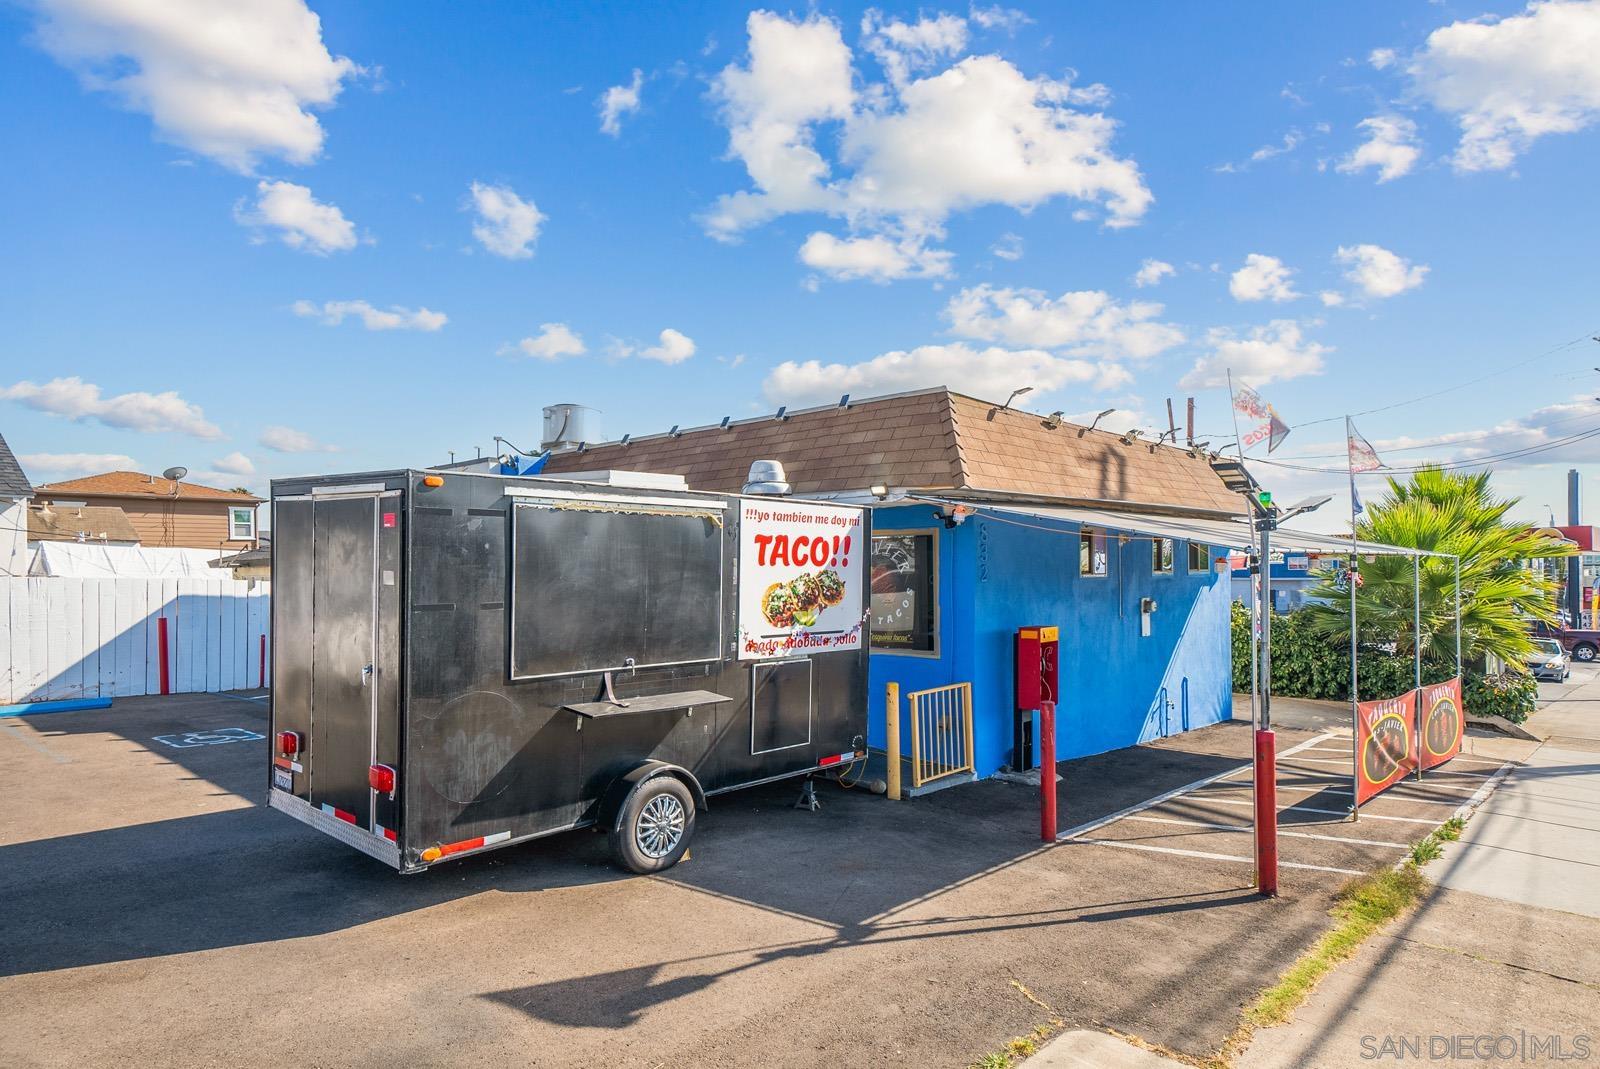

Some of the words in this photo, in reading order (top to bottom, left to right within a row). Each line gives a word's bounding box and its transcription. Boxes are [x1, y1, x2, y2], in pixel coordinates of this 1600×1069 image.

[773, 511, 812, 524] tambien
[815, 516, 829, 525] me
[831, 515, 847, 527] doy
[849, 516, 860, 527] mi
[754, 534, 851, 568] TACO!!
[877, 587, 913, 624] TACOS
[1368, 700, 1406, 724] TAQUERIA
